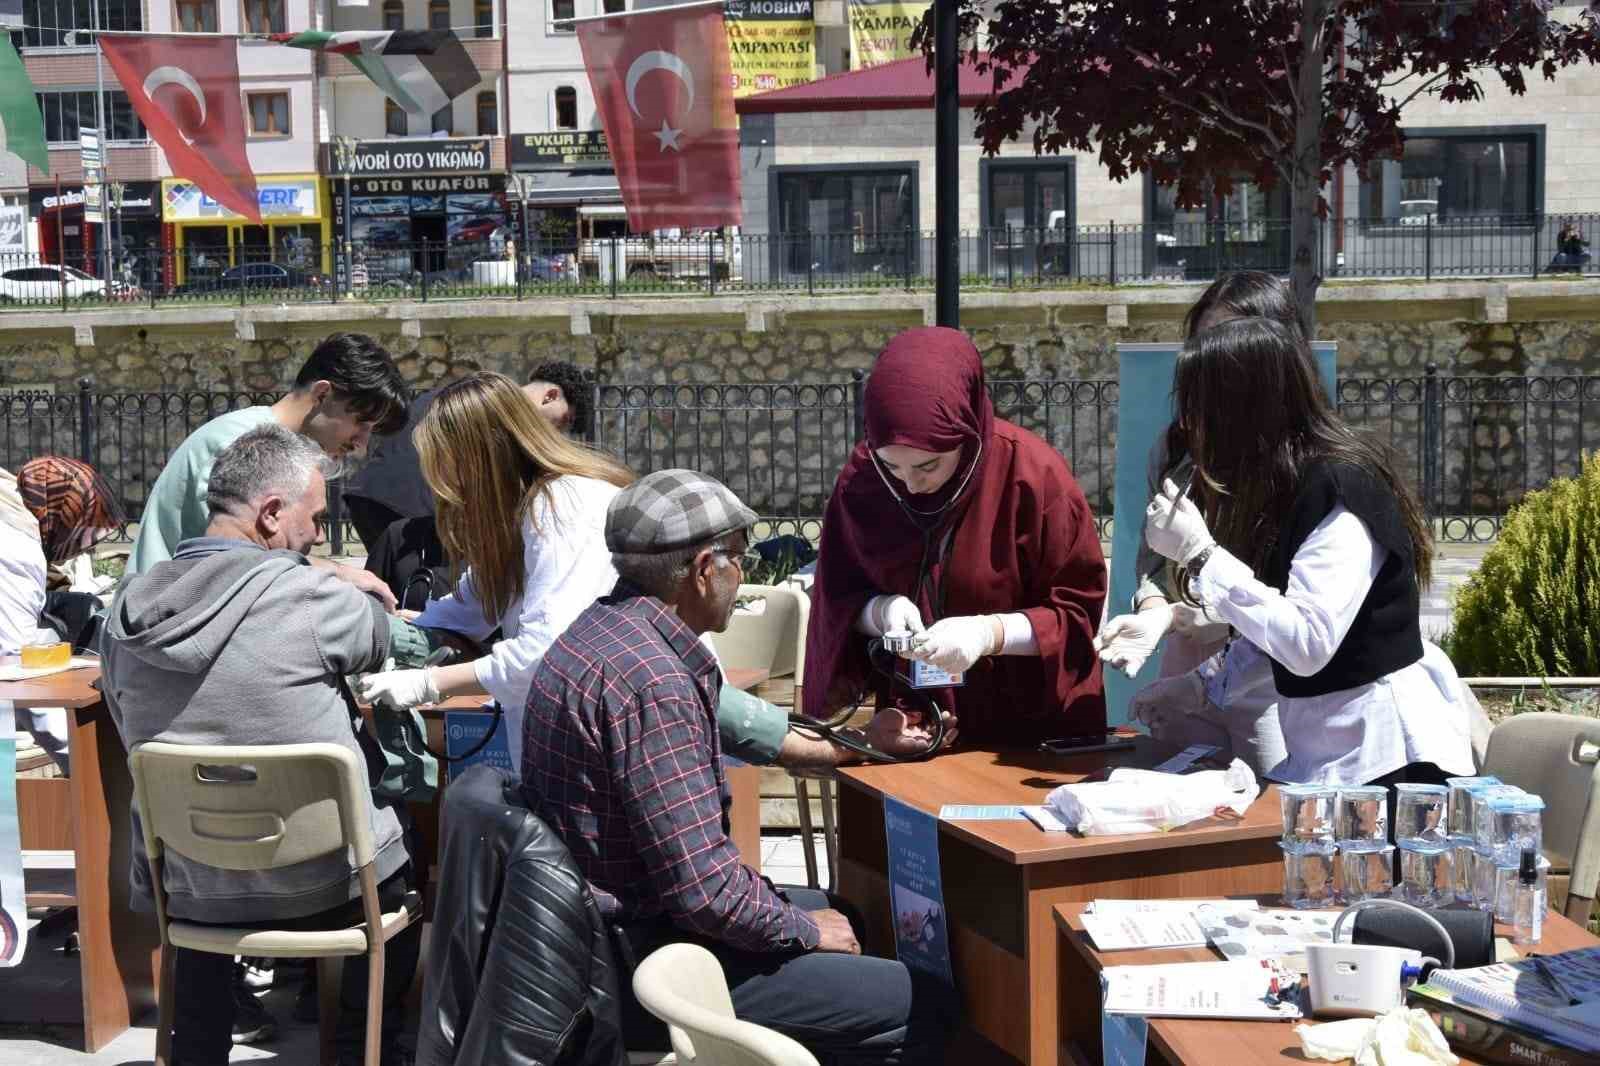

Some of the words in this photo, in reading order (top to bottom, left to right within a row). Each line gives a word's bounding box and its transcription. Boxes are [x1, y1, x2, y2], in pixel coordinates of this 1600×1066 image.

[853, 16, 922, 31] KAMPAN
[731, 41, 809, 53] AMPANYASI
[524, 134, 574, 146] EVKUR
[393, 152, 425, 170] OTO
[427, 150, 485, 170] YIKAMA
[366, 179, 403, 192] OTO
[411, 176, 490, 191] KUAFÖR
[1509, 1042, 1542, 1065] SMART
